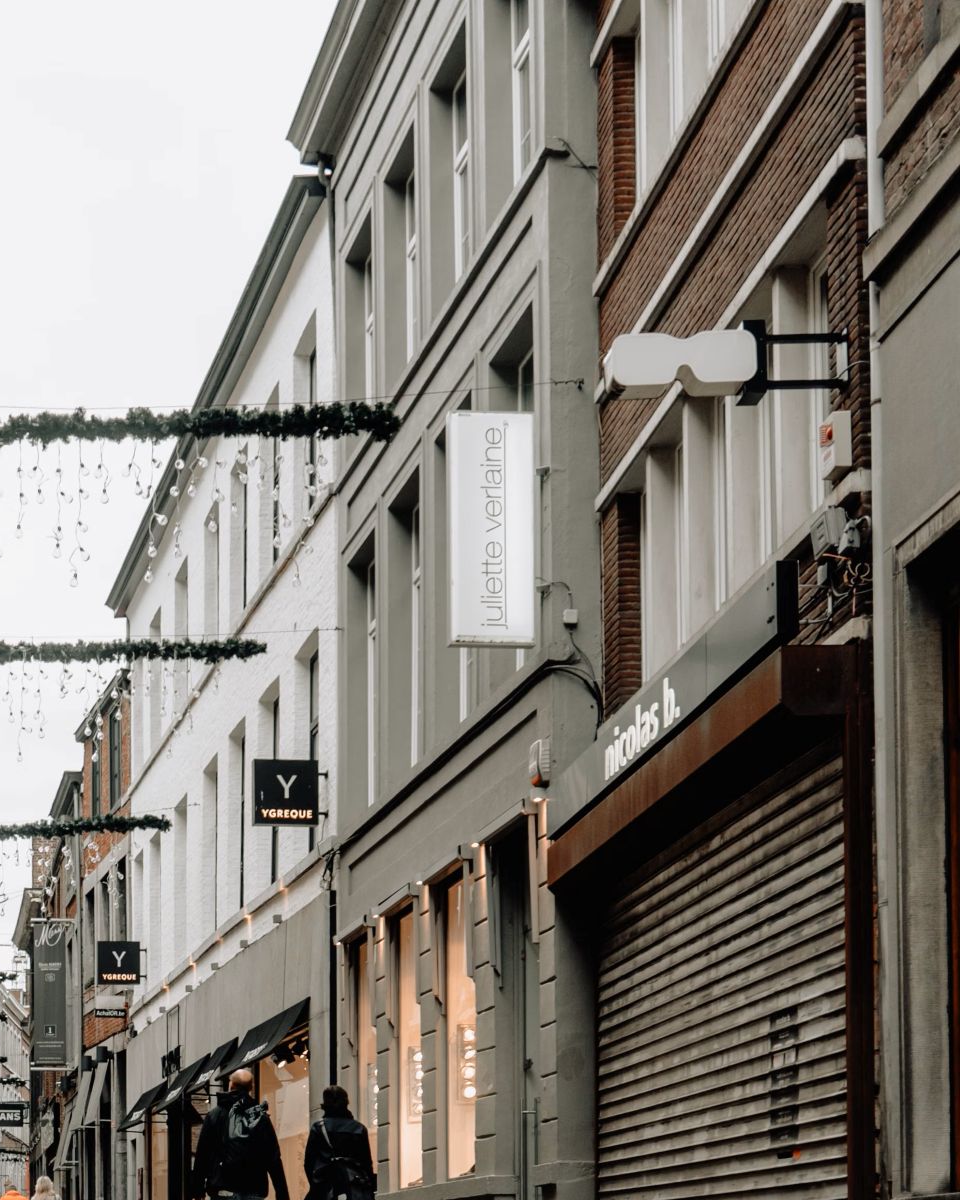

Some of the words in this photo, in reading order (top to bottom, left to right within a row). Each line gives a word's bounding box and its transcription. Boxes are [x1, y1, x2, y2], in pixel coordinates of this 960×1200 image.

[480, 427, 503, 533] verlaine
[480, 541, 508, 629] juliette
[605, 702, 659, 781] nicolas
[663, 677, 680, 729] b.
[276, 774, 298, 799] Y
[261, 808, 313, 820] YGREQUE
[112, 950, 127, 968] Y
[102, 973, 137, 981] YGREQUE
